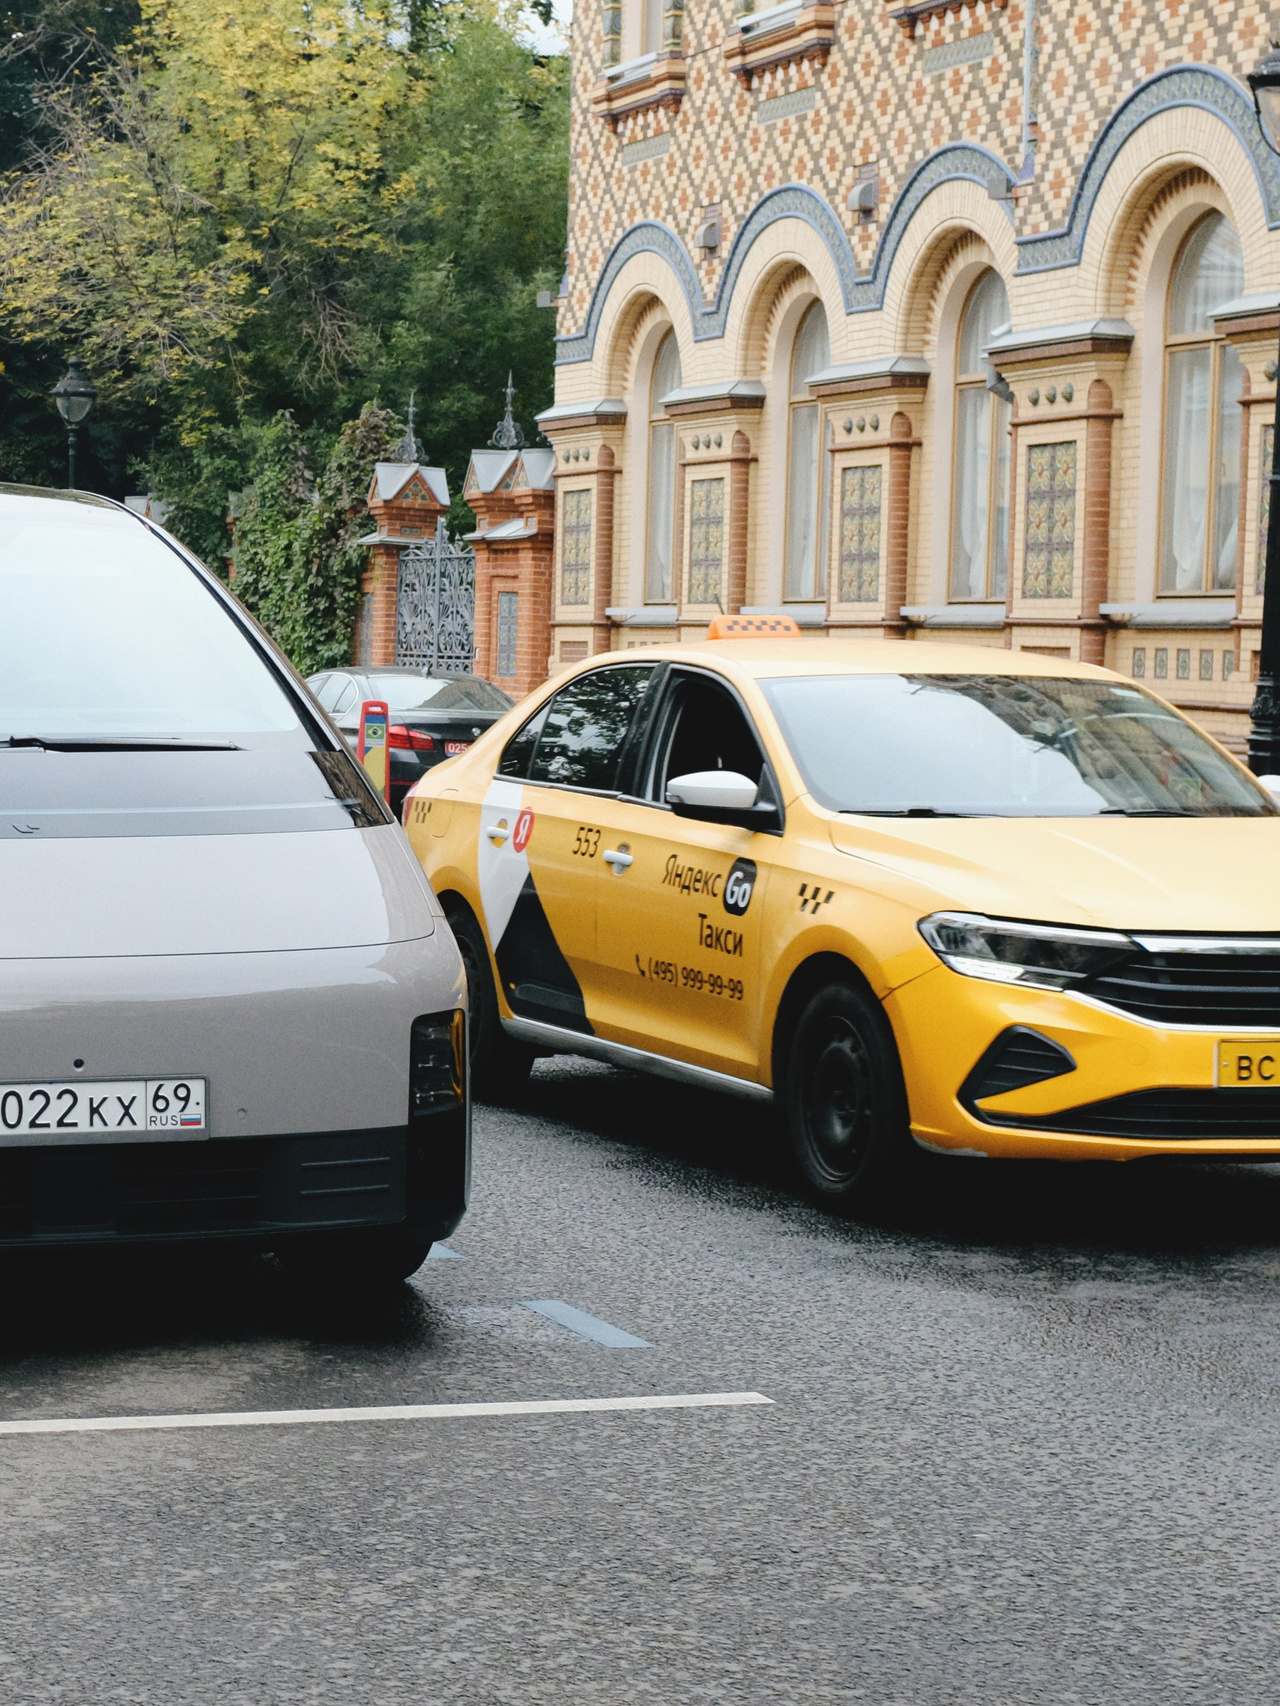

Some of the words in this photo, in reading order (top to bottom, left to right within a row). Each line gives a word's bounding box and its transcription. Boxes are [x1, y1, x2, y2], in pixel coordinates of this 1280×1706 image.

[515, 814, 531, 844] Я
[572, 826, 602, 858] 553
[662, 853, 723, 898] Яндекс
[725, 871, 752, 908] Go
[698, 913, 743, 957] Такси
[648, 957, 679, 987] (495)
[681, 966, 744, 1001] 999-99-99
[152, 1083, 191, 1113] 69
[149, 1115, 179, 1127] RUS
